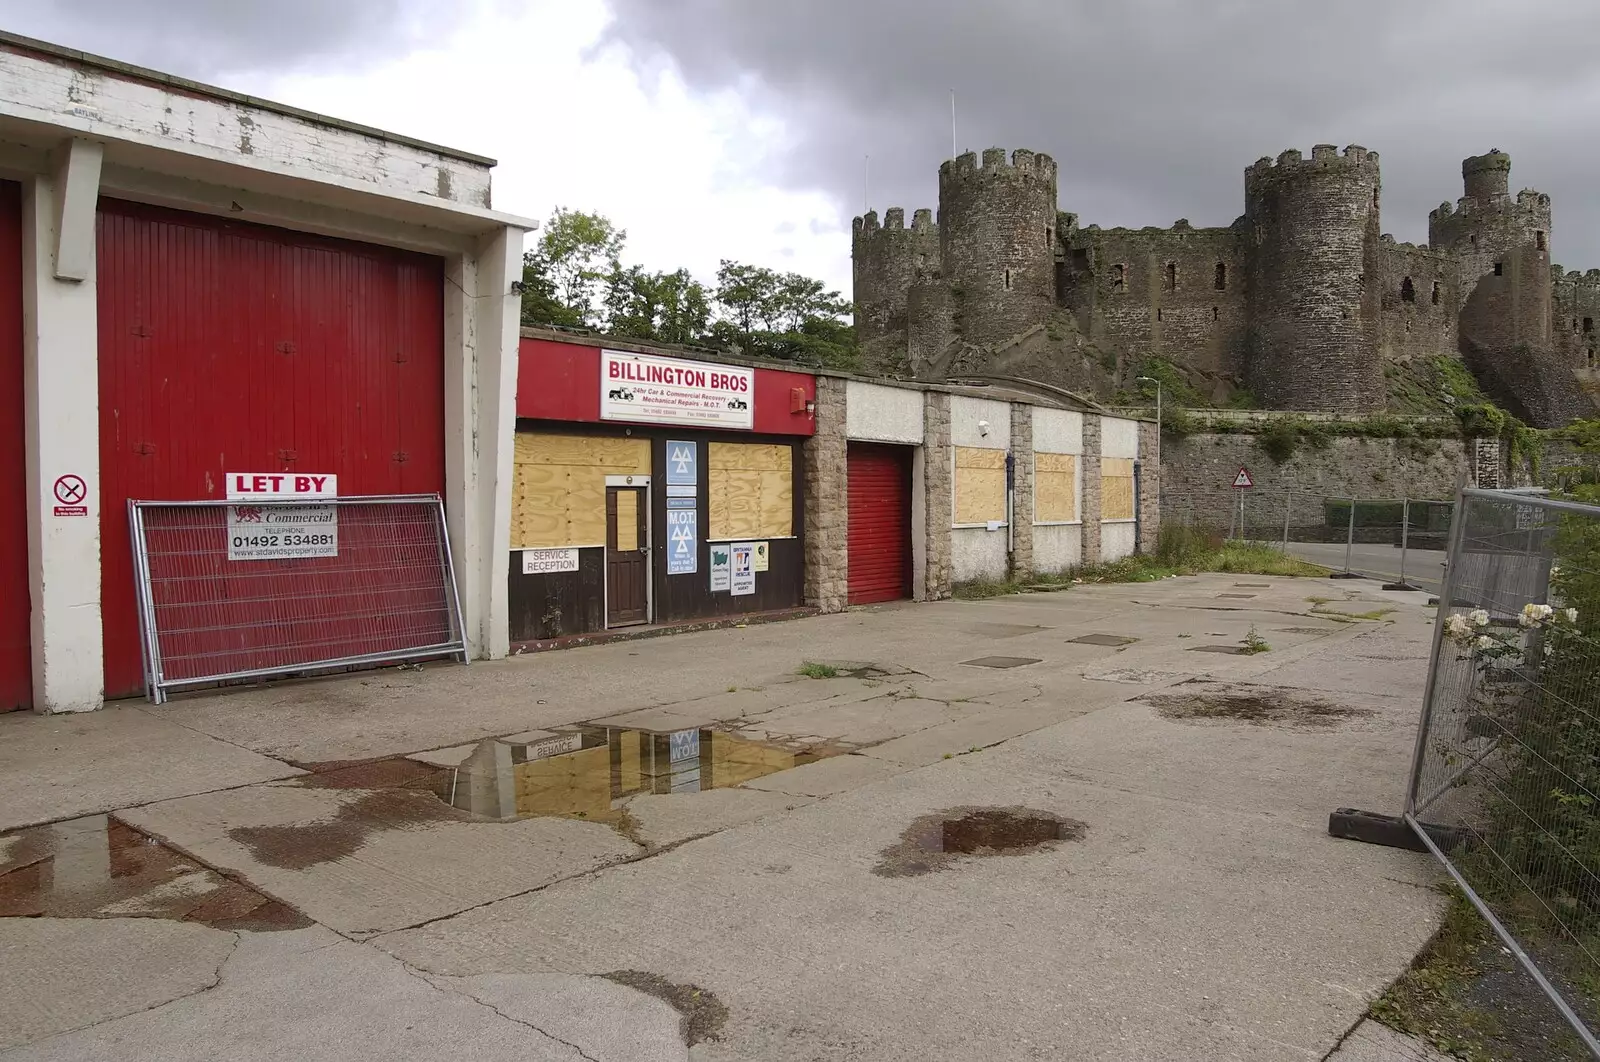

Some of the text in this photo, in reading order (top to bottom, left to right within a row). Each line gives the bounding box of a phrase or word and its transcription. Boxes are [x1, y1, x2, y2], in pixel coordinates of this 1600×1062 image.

[609, 360, 748, 392] BILLINGTON BROS
[642, 396, 676, 405] Mechanical
[677, 399, 699, 407] Repairs
[666, 390, 700, 399] Commercial
[701, 393, 727, 403] Recovery
[236, 475, 327, 493] LET BY
[266, 512, 333, 524] Commercial
[669, 512, 695, 525] M.O.T.
[233, 534, 334, 548] 01492 534881
[233, 546, 335, 557] www.stdavidsproperty.com
[533, 550, 570, 560] SERVICE
[527, 560, 575, 571] RECEPTION
